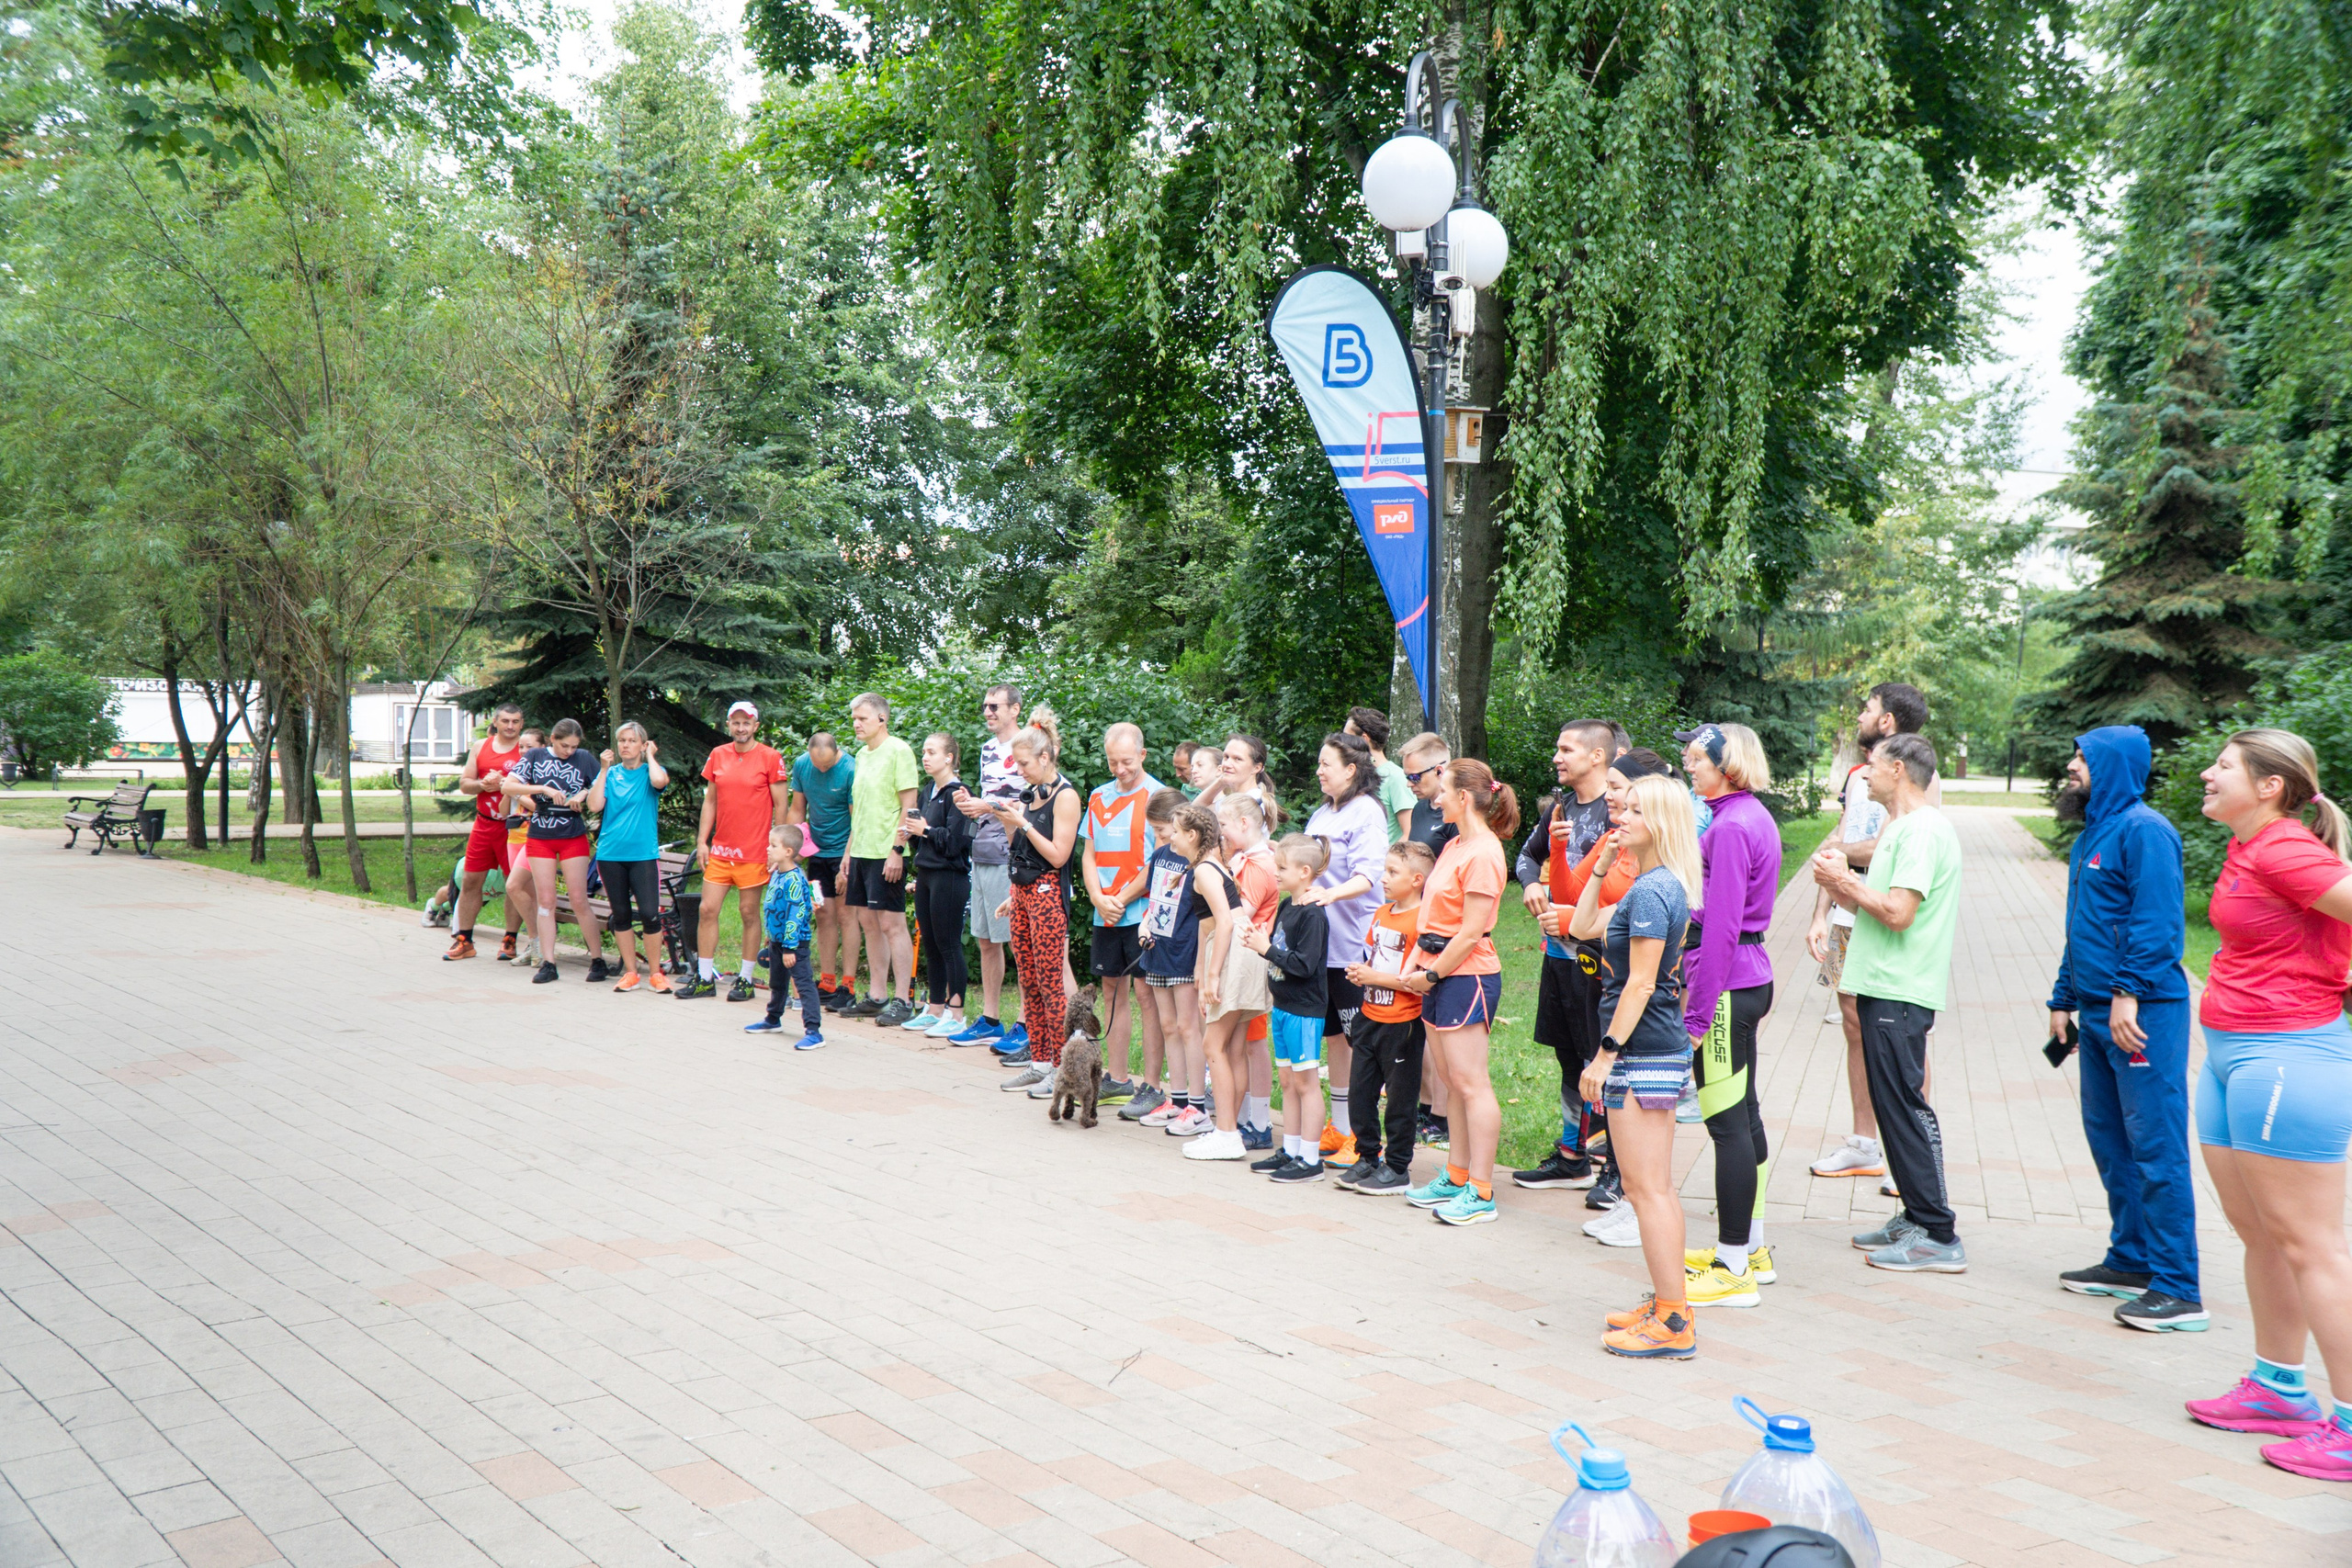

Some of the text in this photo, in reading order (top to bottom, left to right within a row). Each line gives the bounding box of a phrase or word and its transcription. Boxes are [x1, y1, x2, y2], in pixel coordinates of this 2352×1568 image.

[1374, 456, 1410, 465] 5verst.ru
[1374, 988, 1395, 1006] ON!
[2261, 1123, 2273, 1142] NIKE
[1916, 1109, 1947, 1199] RUNNING TEAM
